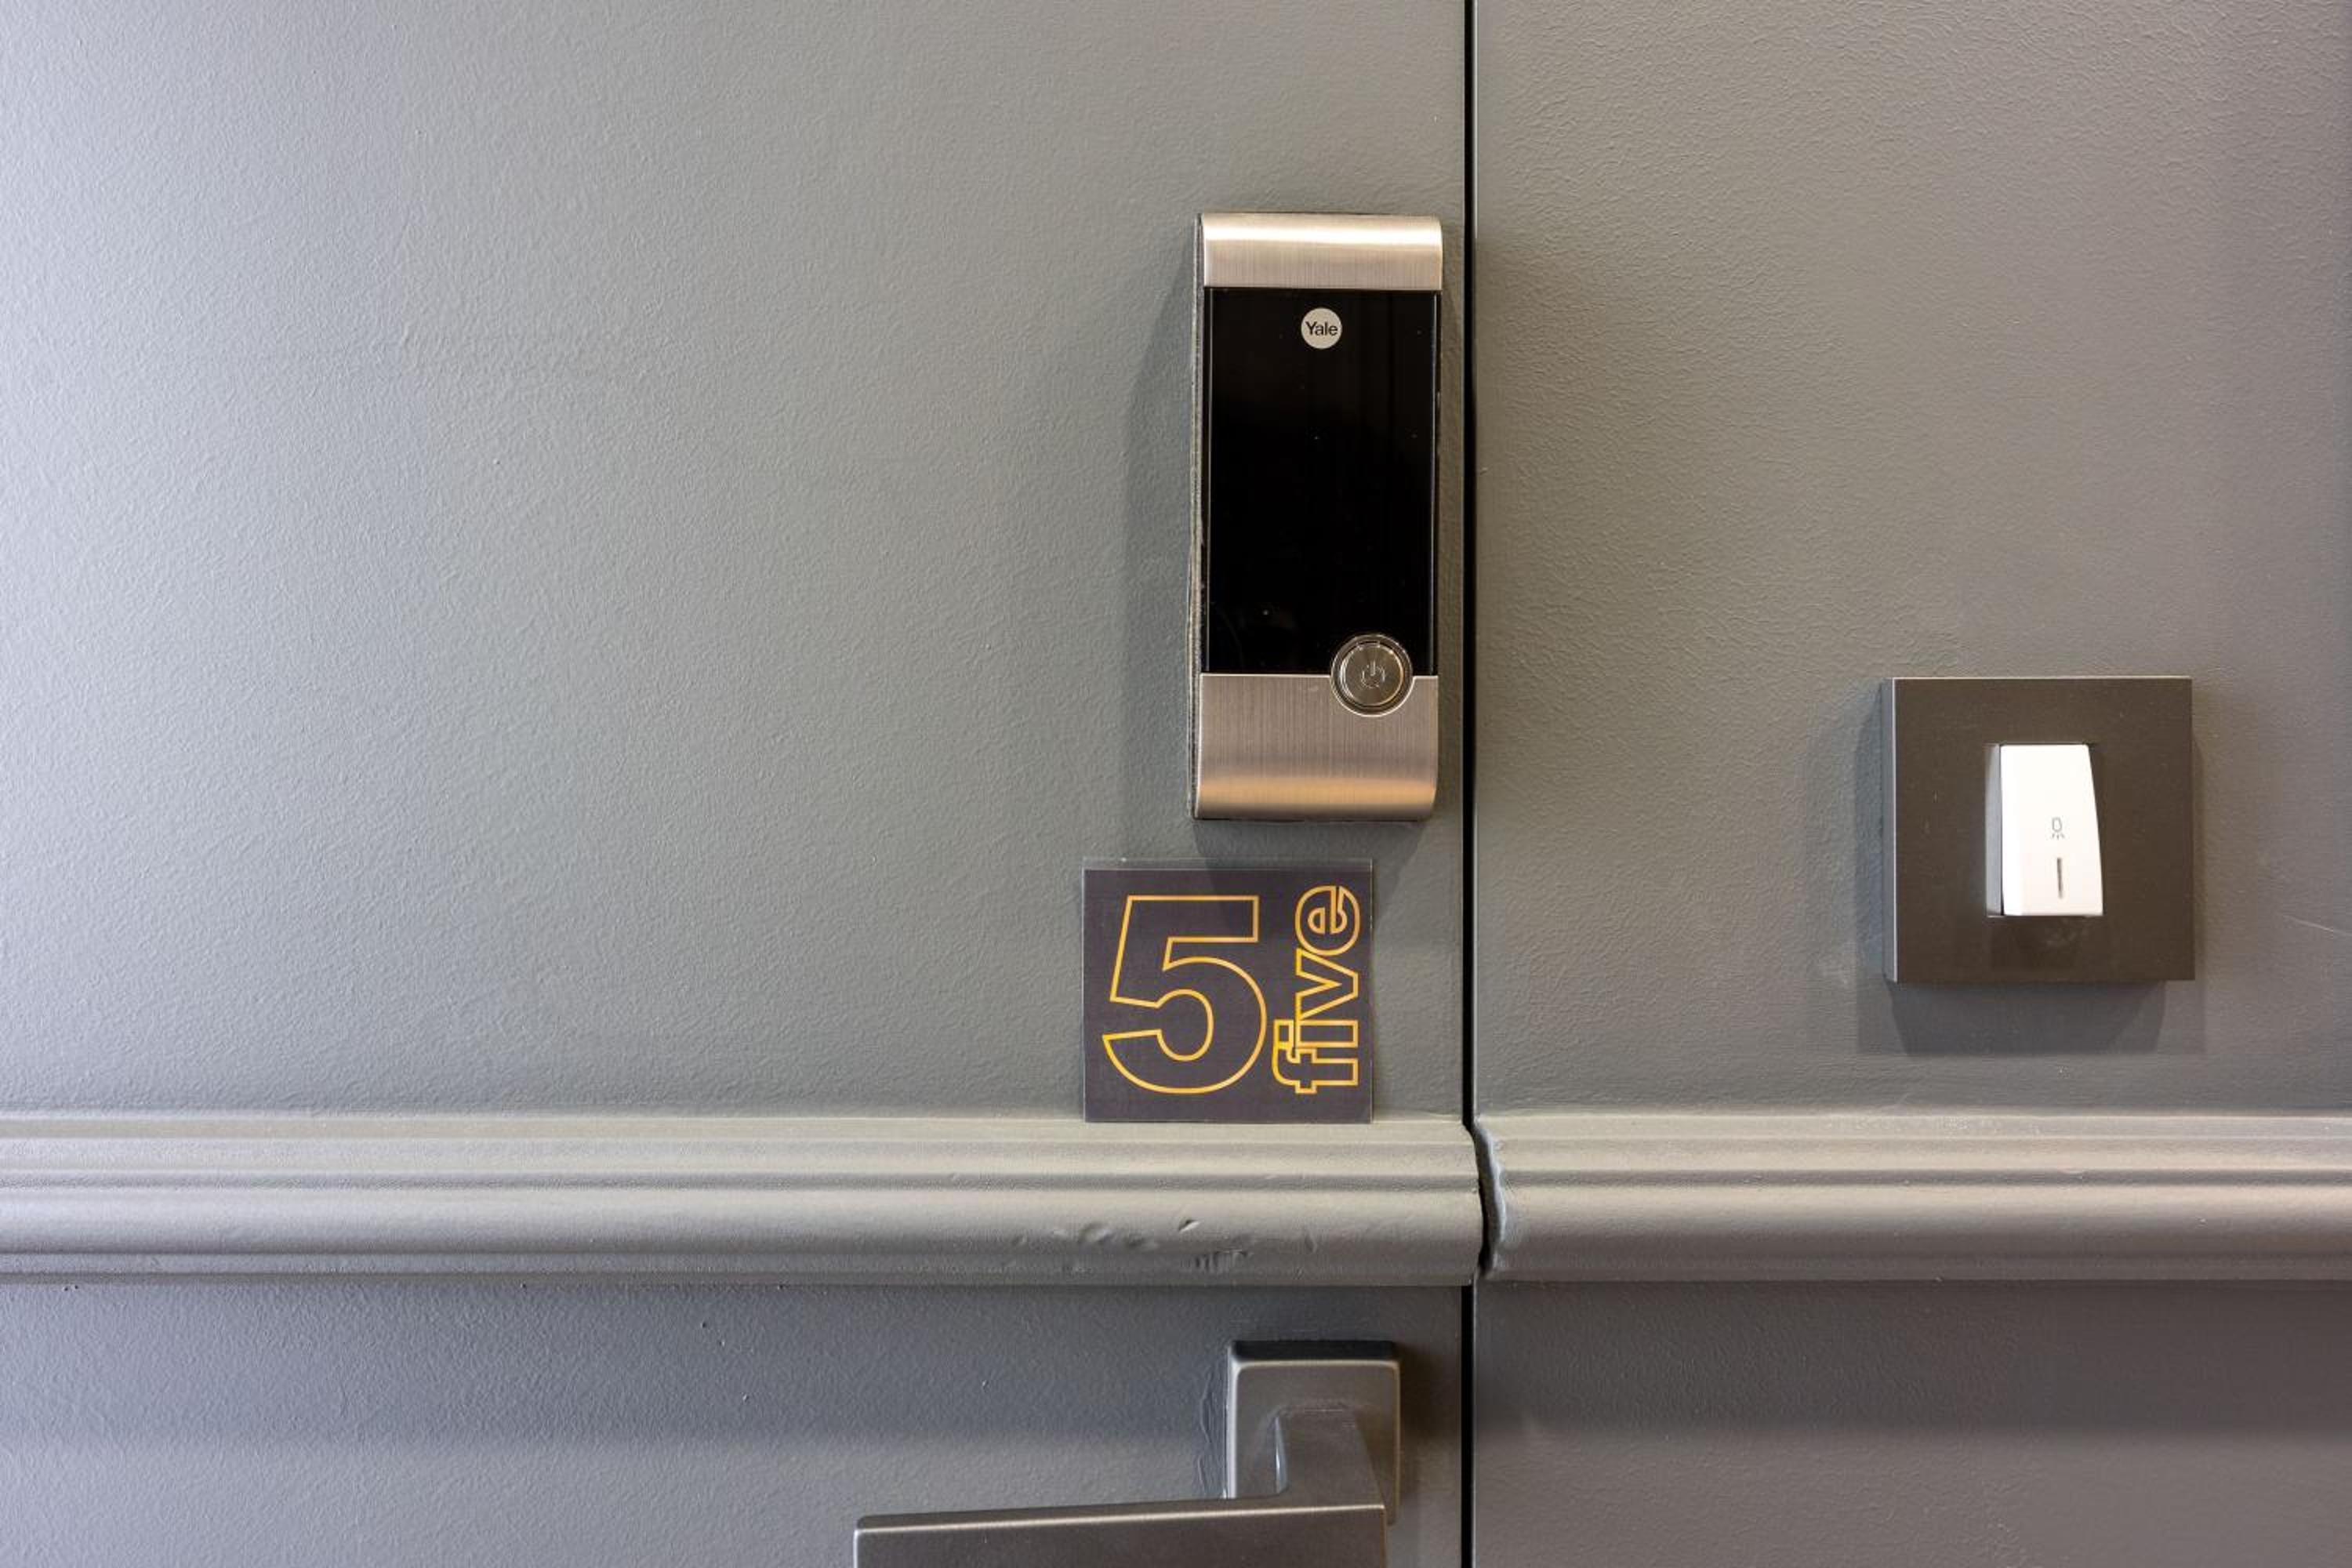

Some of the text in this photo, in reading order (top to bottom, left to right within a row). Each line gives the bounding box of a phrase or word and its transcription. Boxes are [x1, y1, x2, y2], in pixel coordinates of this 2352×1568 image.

[1305, 321, 1338, 336] Yale
[1102, 895, 1267, 1094] 5
[1272, 885, 1360, 1094] five
